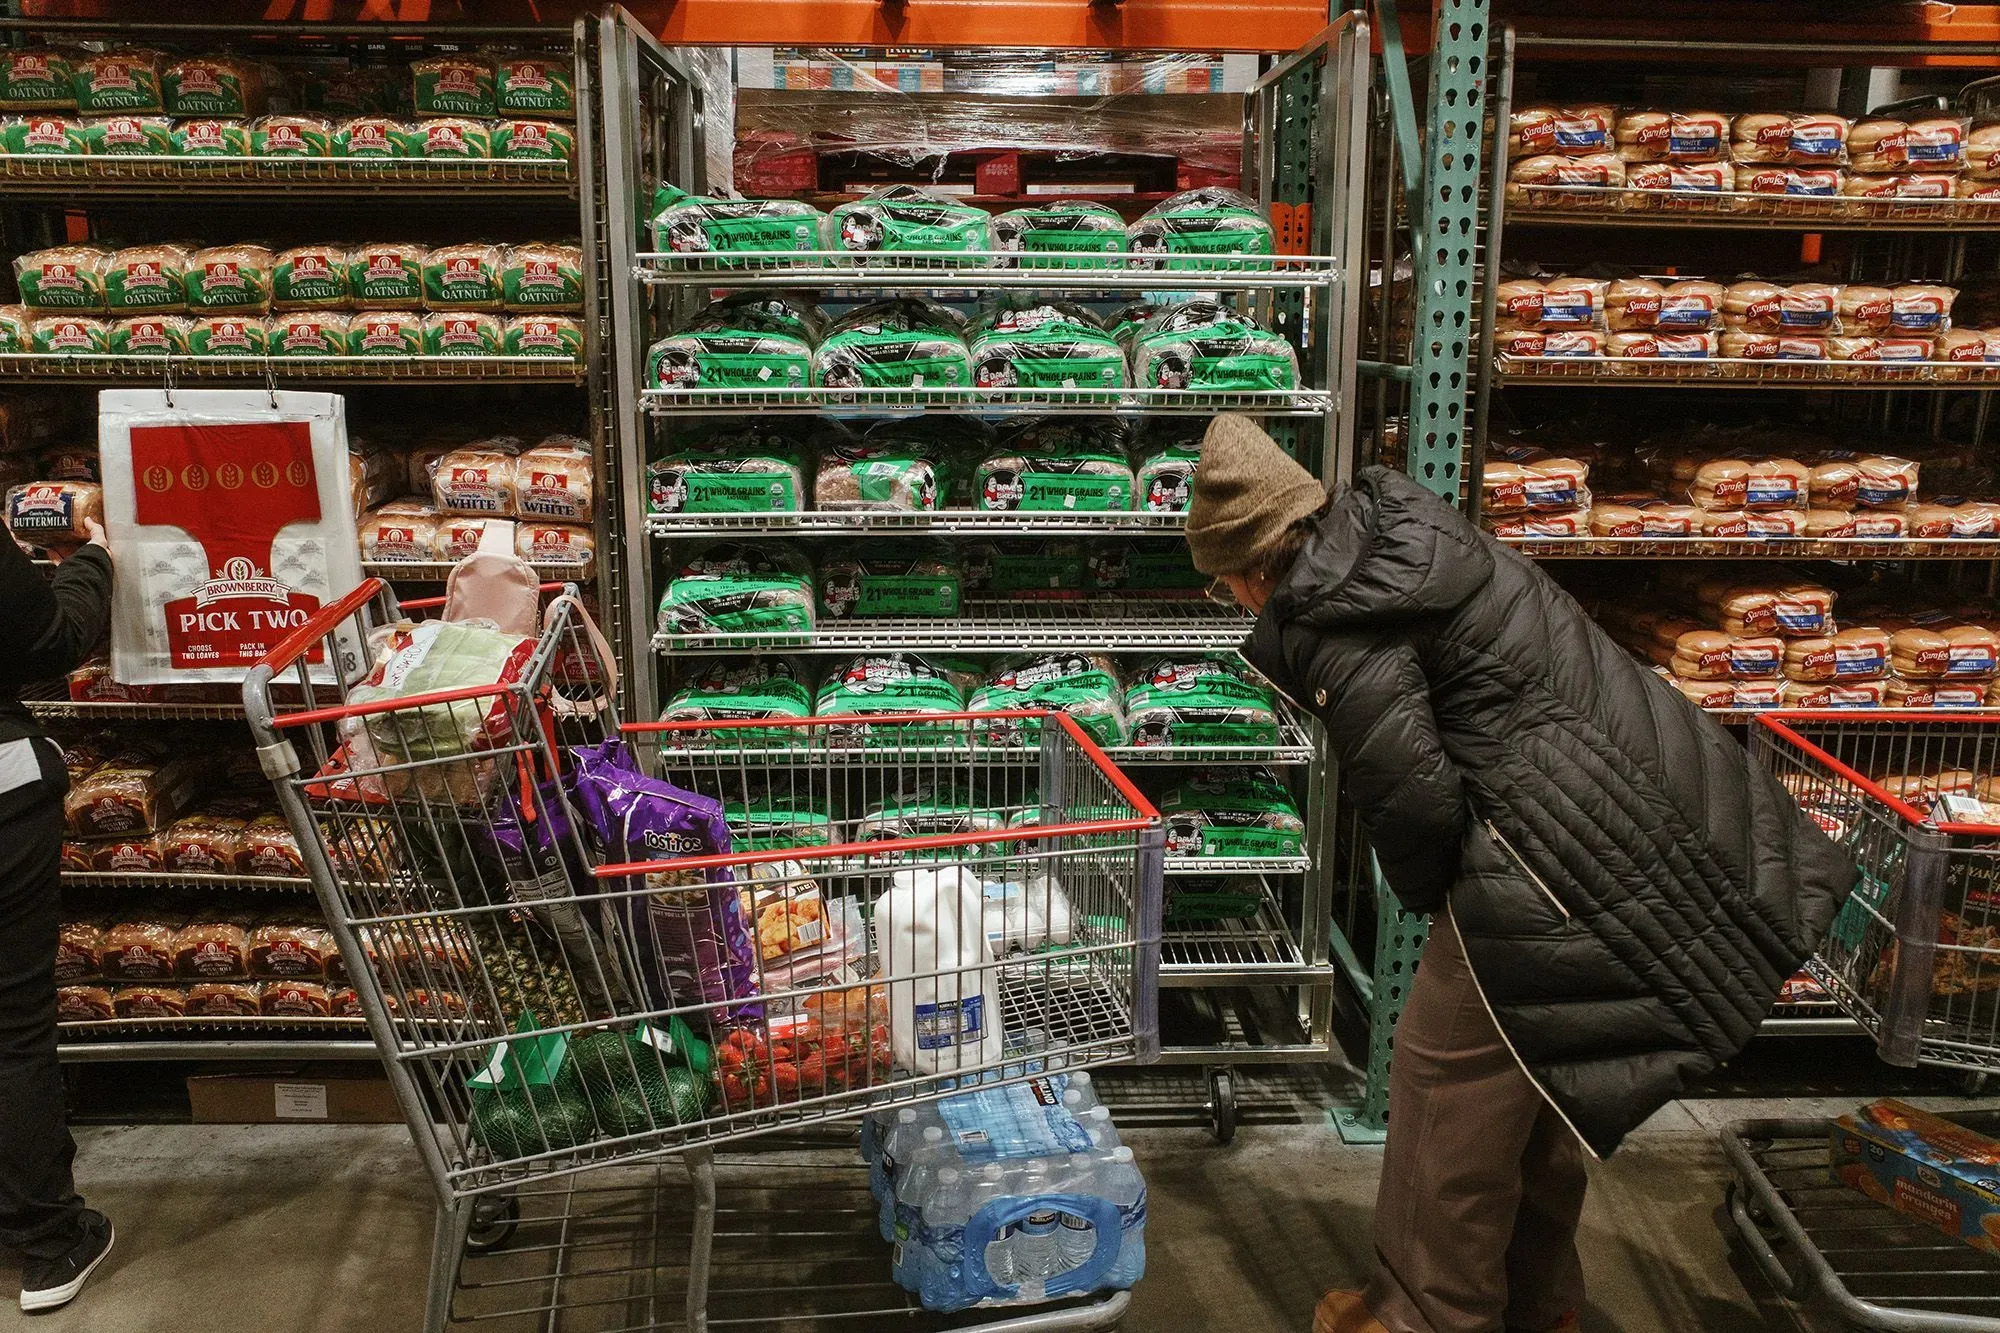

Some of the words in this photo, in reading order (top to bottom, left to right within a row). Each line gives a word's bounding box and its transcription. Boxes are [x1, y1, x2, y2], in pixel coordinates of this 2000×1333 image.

[8, 87, 57, 98] OATNUT
[92, 96, 140, 108] OATNUT
[178, 100, 225, 111] OATNUT
[432, 99, 482, 112] OATNUT
[504, 96, 553, 108] OATNUT
[714, 234, 731, 250] 21
[731, 232, 759, 242] WHOLE
[760, 230, 791, 240] GRAINS
[1047, 243, 1074, 252] WHOLE
[1074, 242, 1101, 252] GRAINS
[1189, 243, 1218, 253] WHOLE
[1218, 241, 1245, 252] GRAINS
[290, 286, 336, 298] OATNUT
[364, 286, 410, 297] OATNUT
[442, 289, 488, 300] OATNUT
[519, 292, 565, 302] OATNUT
[39, 294, 86, 305] OATNUT
[125, 293, 172, 305] OATNUT
[203, 293, 248, 305] OATNUT
[706, 368, 723, 382] 21
[722, 368, 751, 378] WHOLE
[1022, 372, 1038, 386] 21
[1038, 372, 1067, 382] WHOLE
[1068, 370, 1098, 381] GRAINS
[451, 482, 488, 490] BROWNBERRY
[530, 488, 567, 496] BROWNBERRY
[997, 484, 1022, 492] DAVE'S
[694, 488, 710, 502] 21
[710, 487, 737, 496] WHOLE
[738, 486, 766, 496] GRAINS
[996, 492, 1023, 500] BREAD
[1029, 486, 1046, 500] 21
[1046, 488, 1074, 498] WHOLE
[1075, 487, 1104, 497] GRAINS
[446, 498, 496, 510] WHITE
[524, 502, 575, 516] WHITE
[13, 516, 68, 528] BUTTERMILK
[207, 582, 275, 594] BROWNBERRY
[866, 588, 883, 602] 21
[883, 588, 908, 596] WHOLE
[909, 587, 936, 596] GRAINS
[180, 612, 240, 632] PICK
[248, 610, 308, 629] TWO
[188, 644, 212, 652] CHOOSE
[197, 651, 219, 659] LOAVES
[865, 668, 912, 679] BREAD
[895, 685, 916, 697] 21
[1205, 681, 1227, 696] 21
[1224, 839, 1251, 848] WHOLE
[1252, 838, 1278, 849] GRAINS
[1870, 1144, 1884, 1156] 20
[1896, 1179, 1958, 1212] mandarin
[1901, 1191, 1952, 1220] oranges
